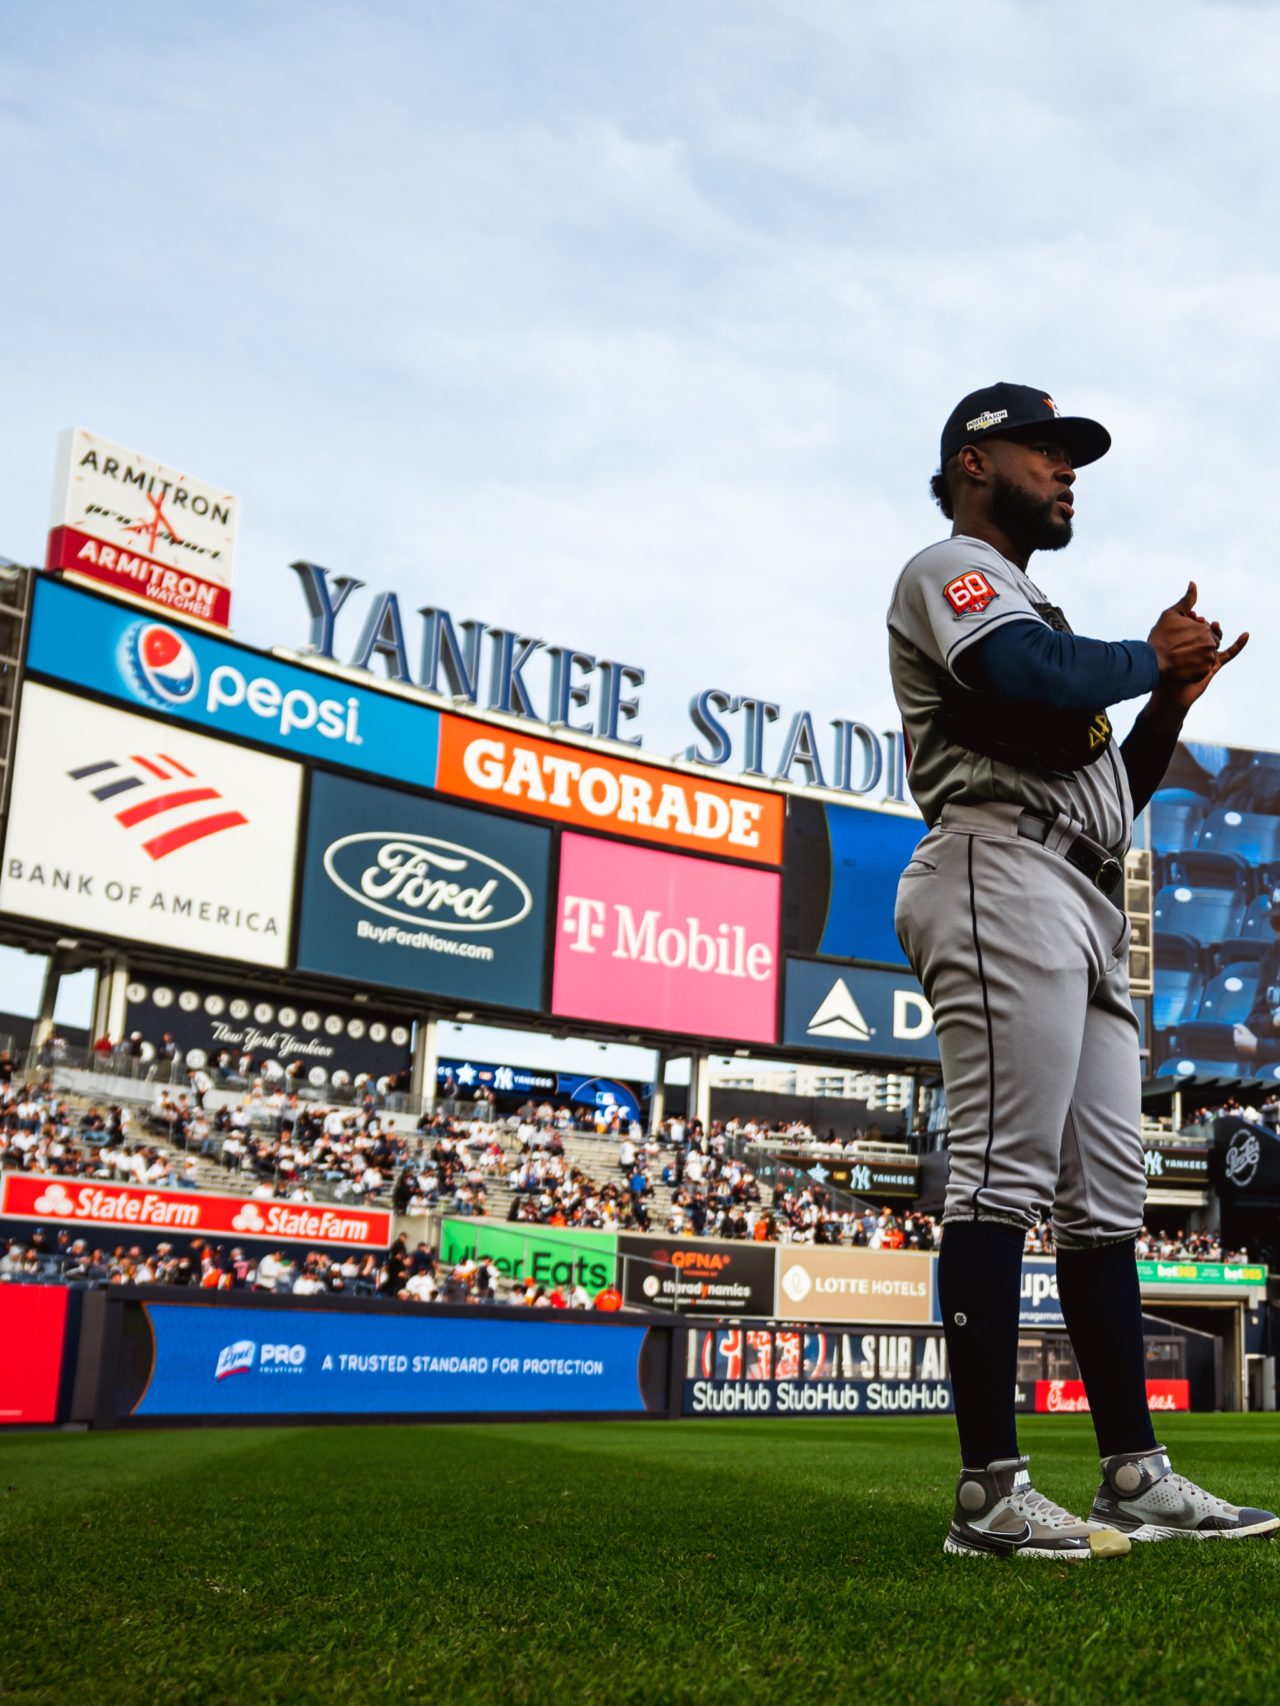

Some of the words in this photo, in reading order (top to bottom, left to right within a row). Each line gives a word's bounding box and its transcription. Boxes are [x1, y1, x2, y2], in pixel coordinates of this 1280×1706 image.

[80, 450, 230, 526] ARMITRON
[77, 540, 218, 606] ARMITRON
[948, 574, 988, 606] 60
[146, 583, 213, 617] WATCHES
[289, 559, 645, 748] YANKEE
[206, 665, 359, 744] pepsi
[463, 738, 761, 848] GATORADE
[8, 858, 94, 898] BANK
[105, 881, 141, 905] OF
[150, 892, 279, 936] AMERICA
[361, 842, 498, 921] Ford
[357, 920, 494, 961] BuyFordNow.com
[612, 904, 773, 982] Mobile
[211, 1020, 243, 1043] New
[243, 1027, 277, 1052] York
[277, 1033, 335, 1057] Yankees
[872, 1174, 915, 1185] YANKEES
[1165, 1159, 1208, 1170] YANKEES
[448, 1245, 523, 1279] Uer
[532, 1251, 608, 1289] Eats
[815, 1276, 868, 1295] LOTTE
[871, 1279, 927, 1297] HOTELS
[260, 1343, 306, 1365] PRO
[321, 1354, 333, 1371] A
[339, 1354, 407, 1372] TRUSTED
[412, 1356, 488, 1374] STANDARD
[492, 1357, 519, 1374] FOR
[523, 1359, 604, 1375] PROTECTION
[861, 1335, 912, 1380] SUB
[692, 1381, 771, 1412] StubHub
[776, 1381, 859, 1412] StubHub
[866, 1382, 949, 1411] StubHub
